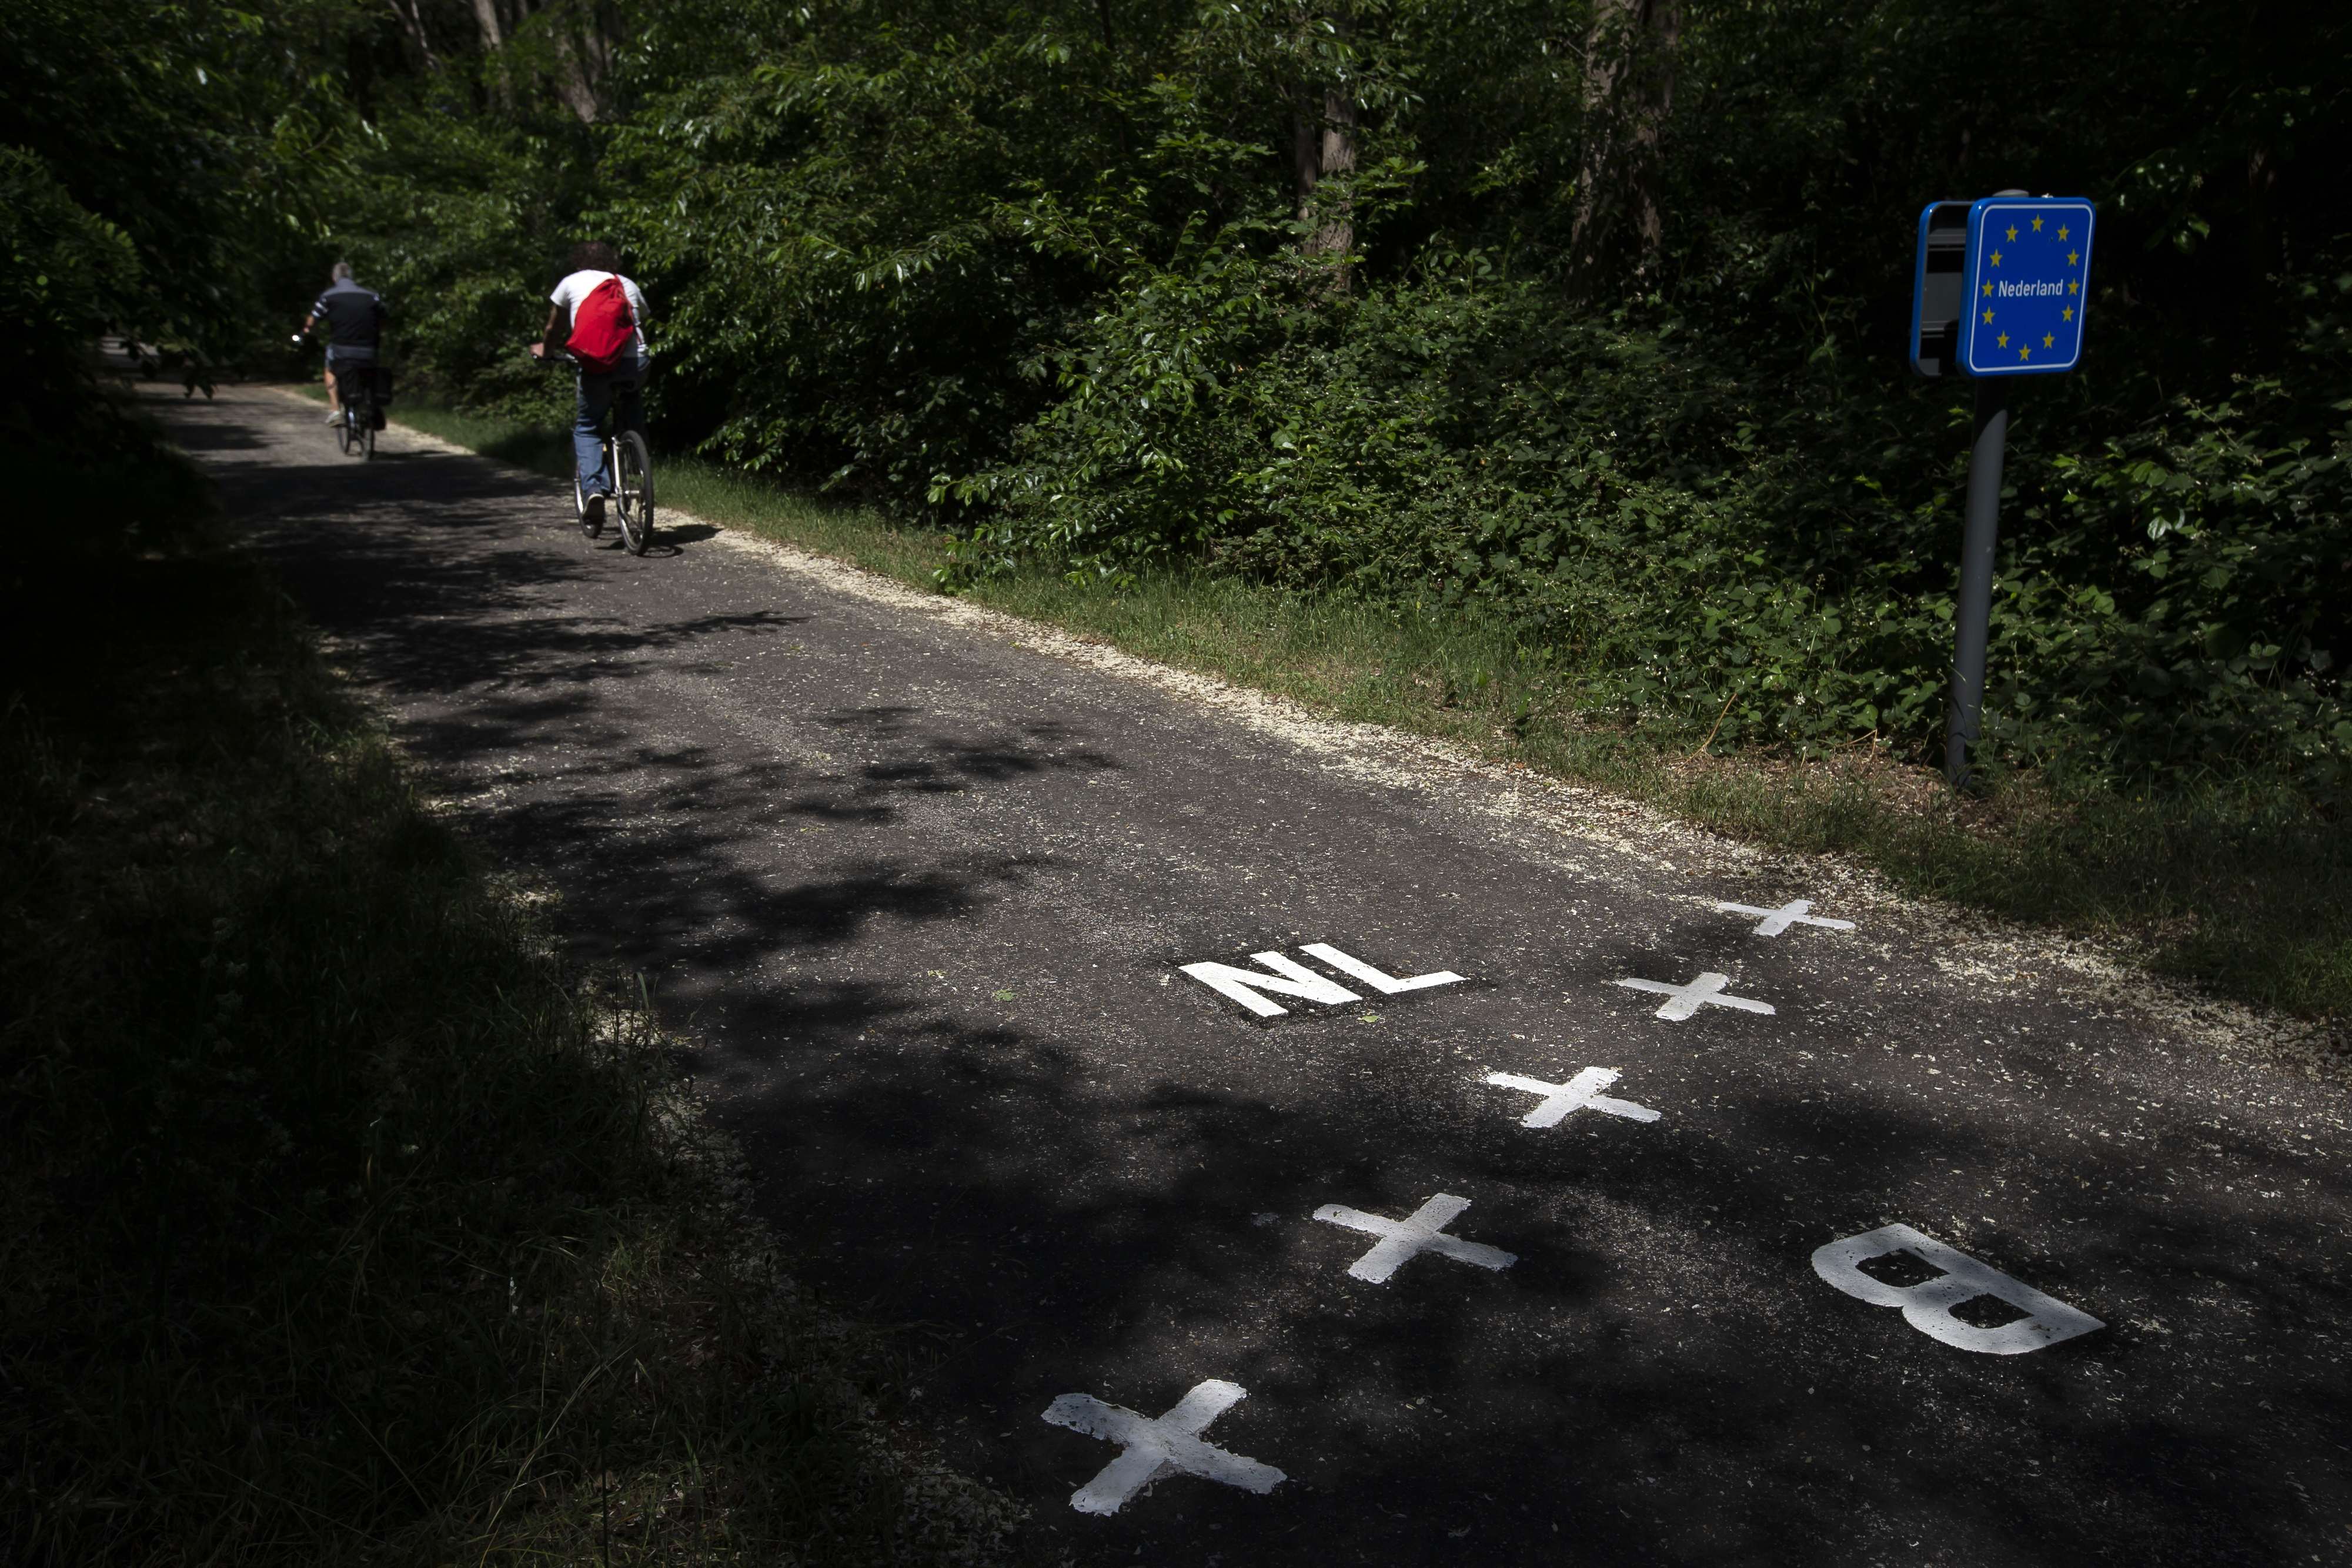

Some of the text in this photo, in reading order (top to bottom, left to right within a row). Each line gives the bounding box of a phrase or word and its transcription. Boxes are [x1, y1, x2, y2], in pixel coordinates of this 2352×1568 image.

[1999, 279, 2063, 297] Nederland
[1178, 942, 1469, 1017] NL
[1811, 1223, 2107, 1355] B
